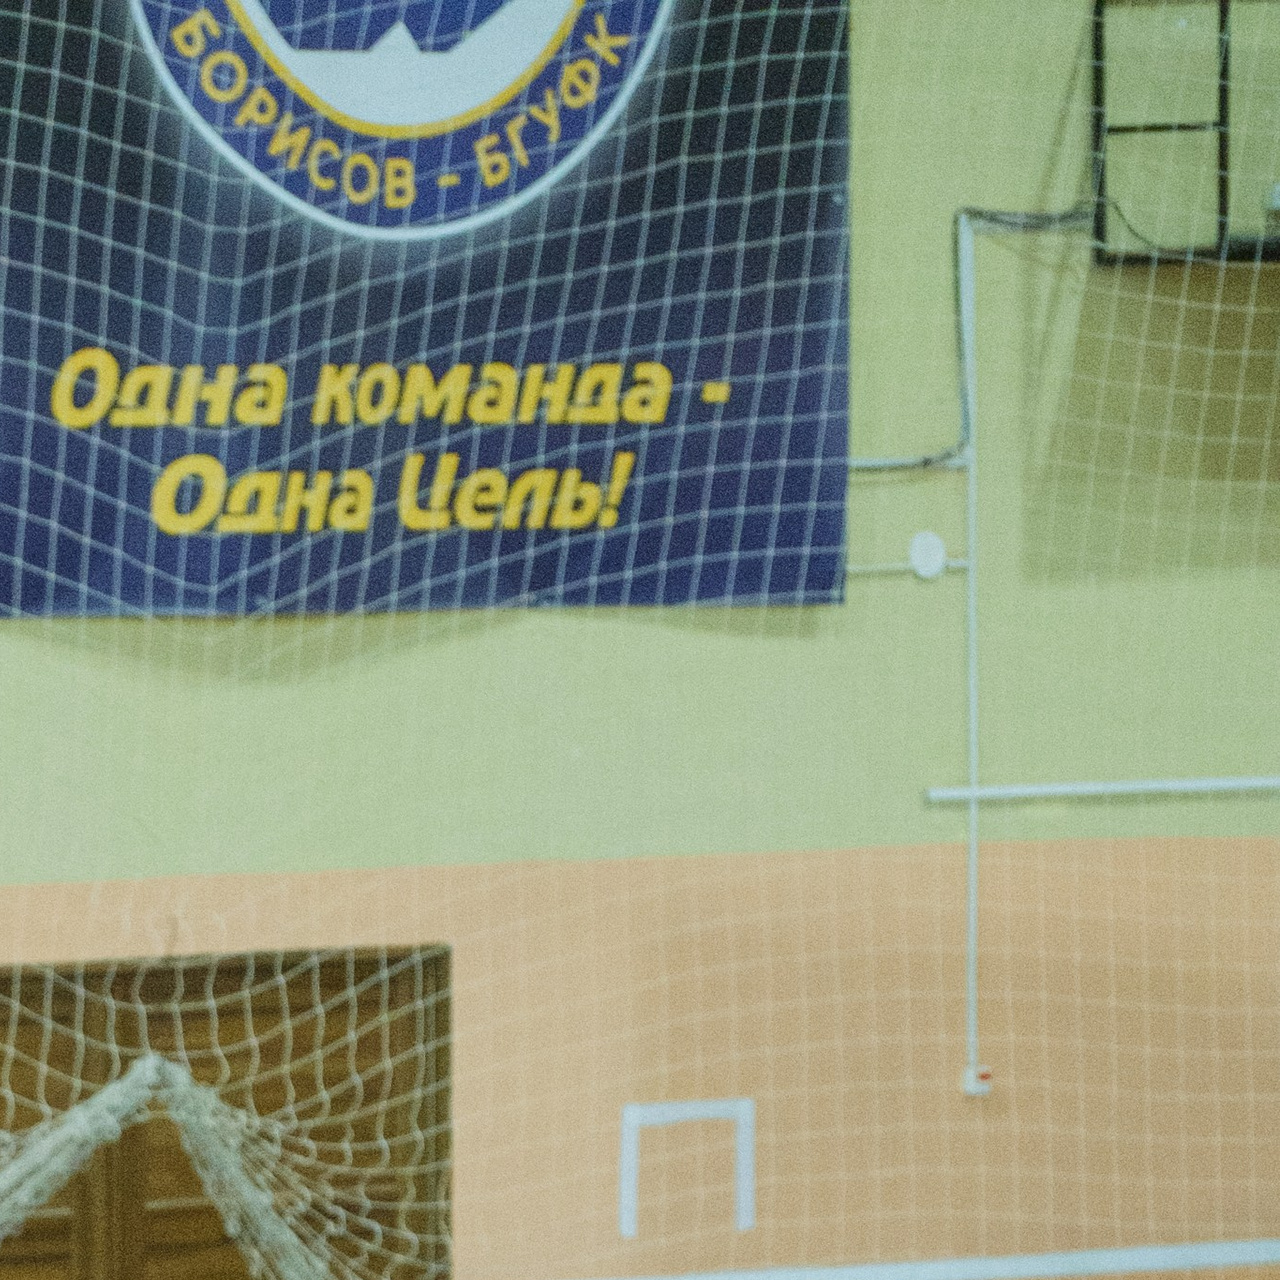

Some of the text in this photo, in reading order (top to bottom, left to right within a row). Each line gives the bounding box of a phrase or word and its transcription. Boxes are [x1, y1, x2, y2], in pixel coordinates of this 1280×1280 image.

[167, 8, 417, 210] БОРИСОВ
[474, 28, 634, 190] БГУФК
[50, 346, 290, 430] Одна
[310, 360, 675, 427] команда
[150, 450, 636, 536] Одна Цель!
